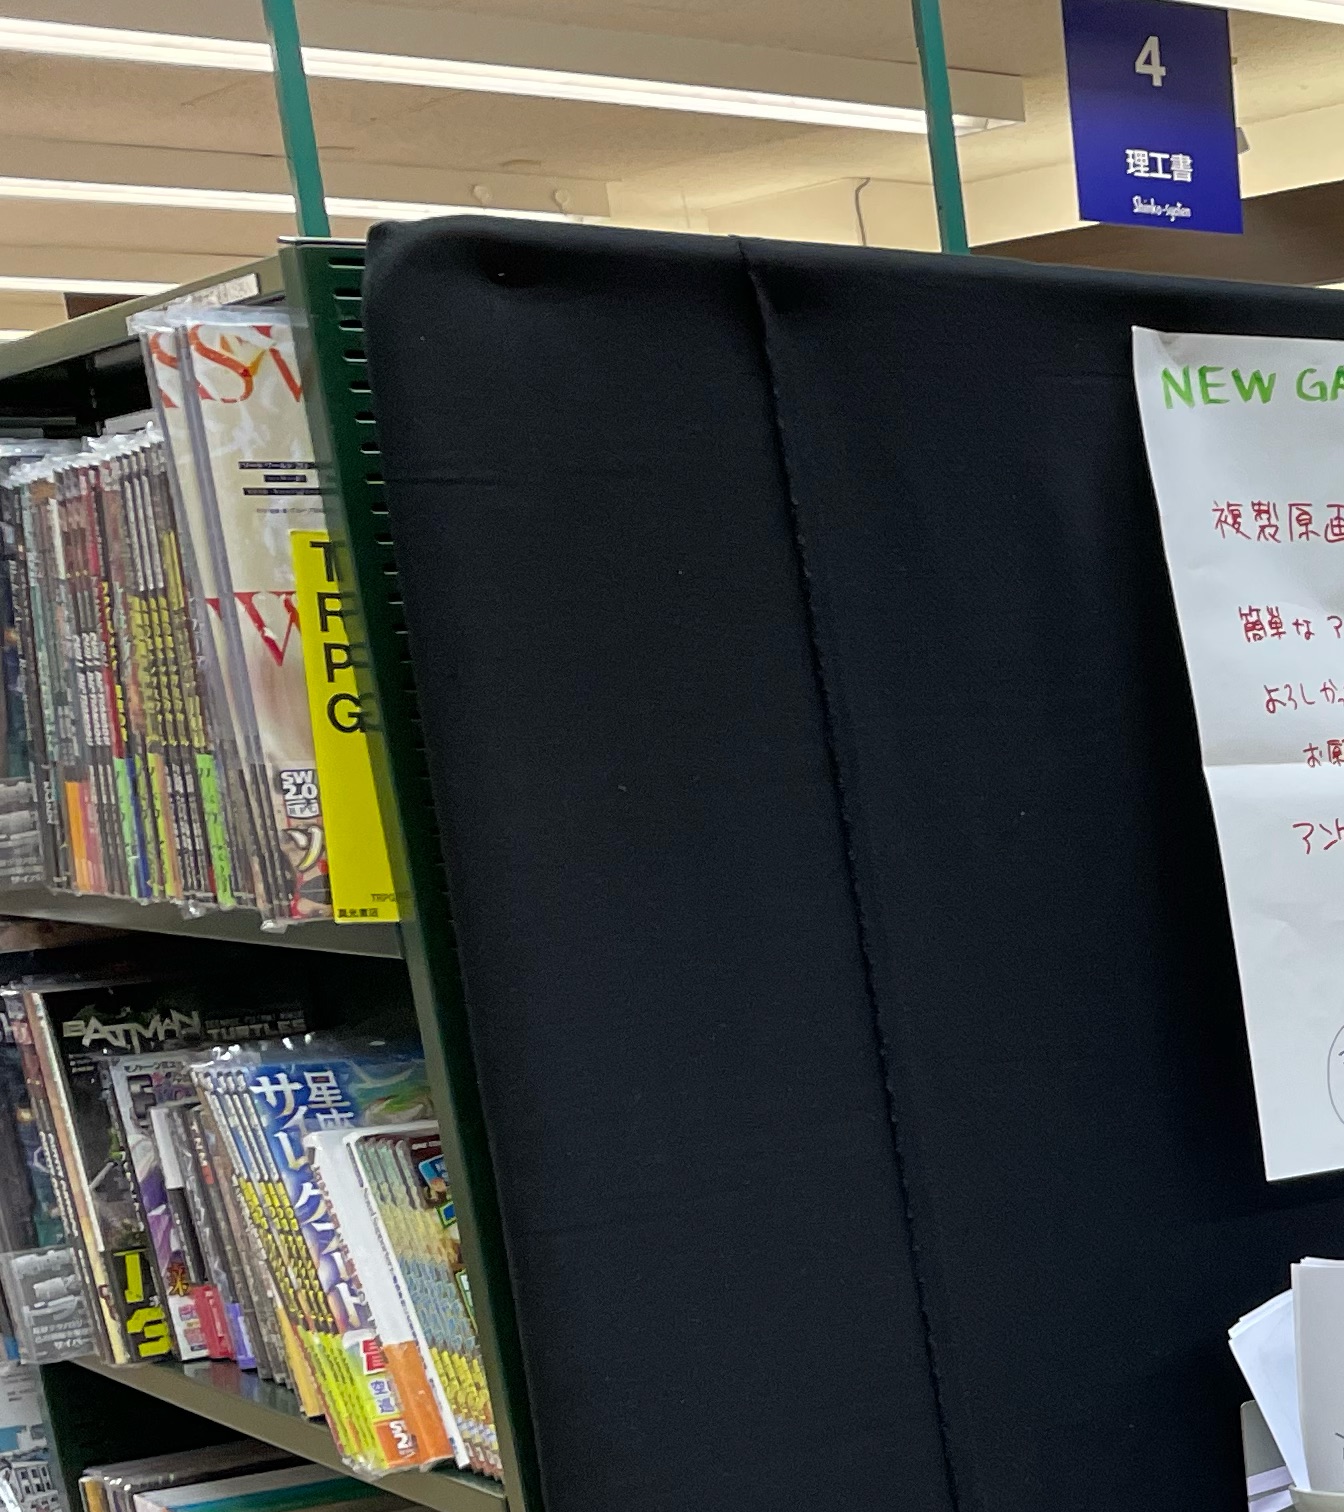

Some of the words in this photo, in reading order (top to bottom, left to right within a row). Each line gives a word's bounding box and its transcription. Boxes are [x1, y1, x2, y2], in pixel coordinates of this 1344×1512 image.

[1134, 35, 1167, 88] 4
[1125, 148, 1194, 183] 理工書
[1160, 365, 1278, 410] NEW
[309, 540, 367, 734] TRPG
[283, 783, 318, 800] 2.0
